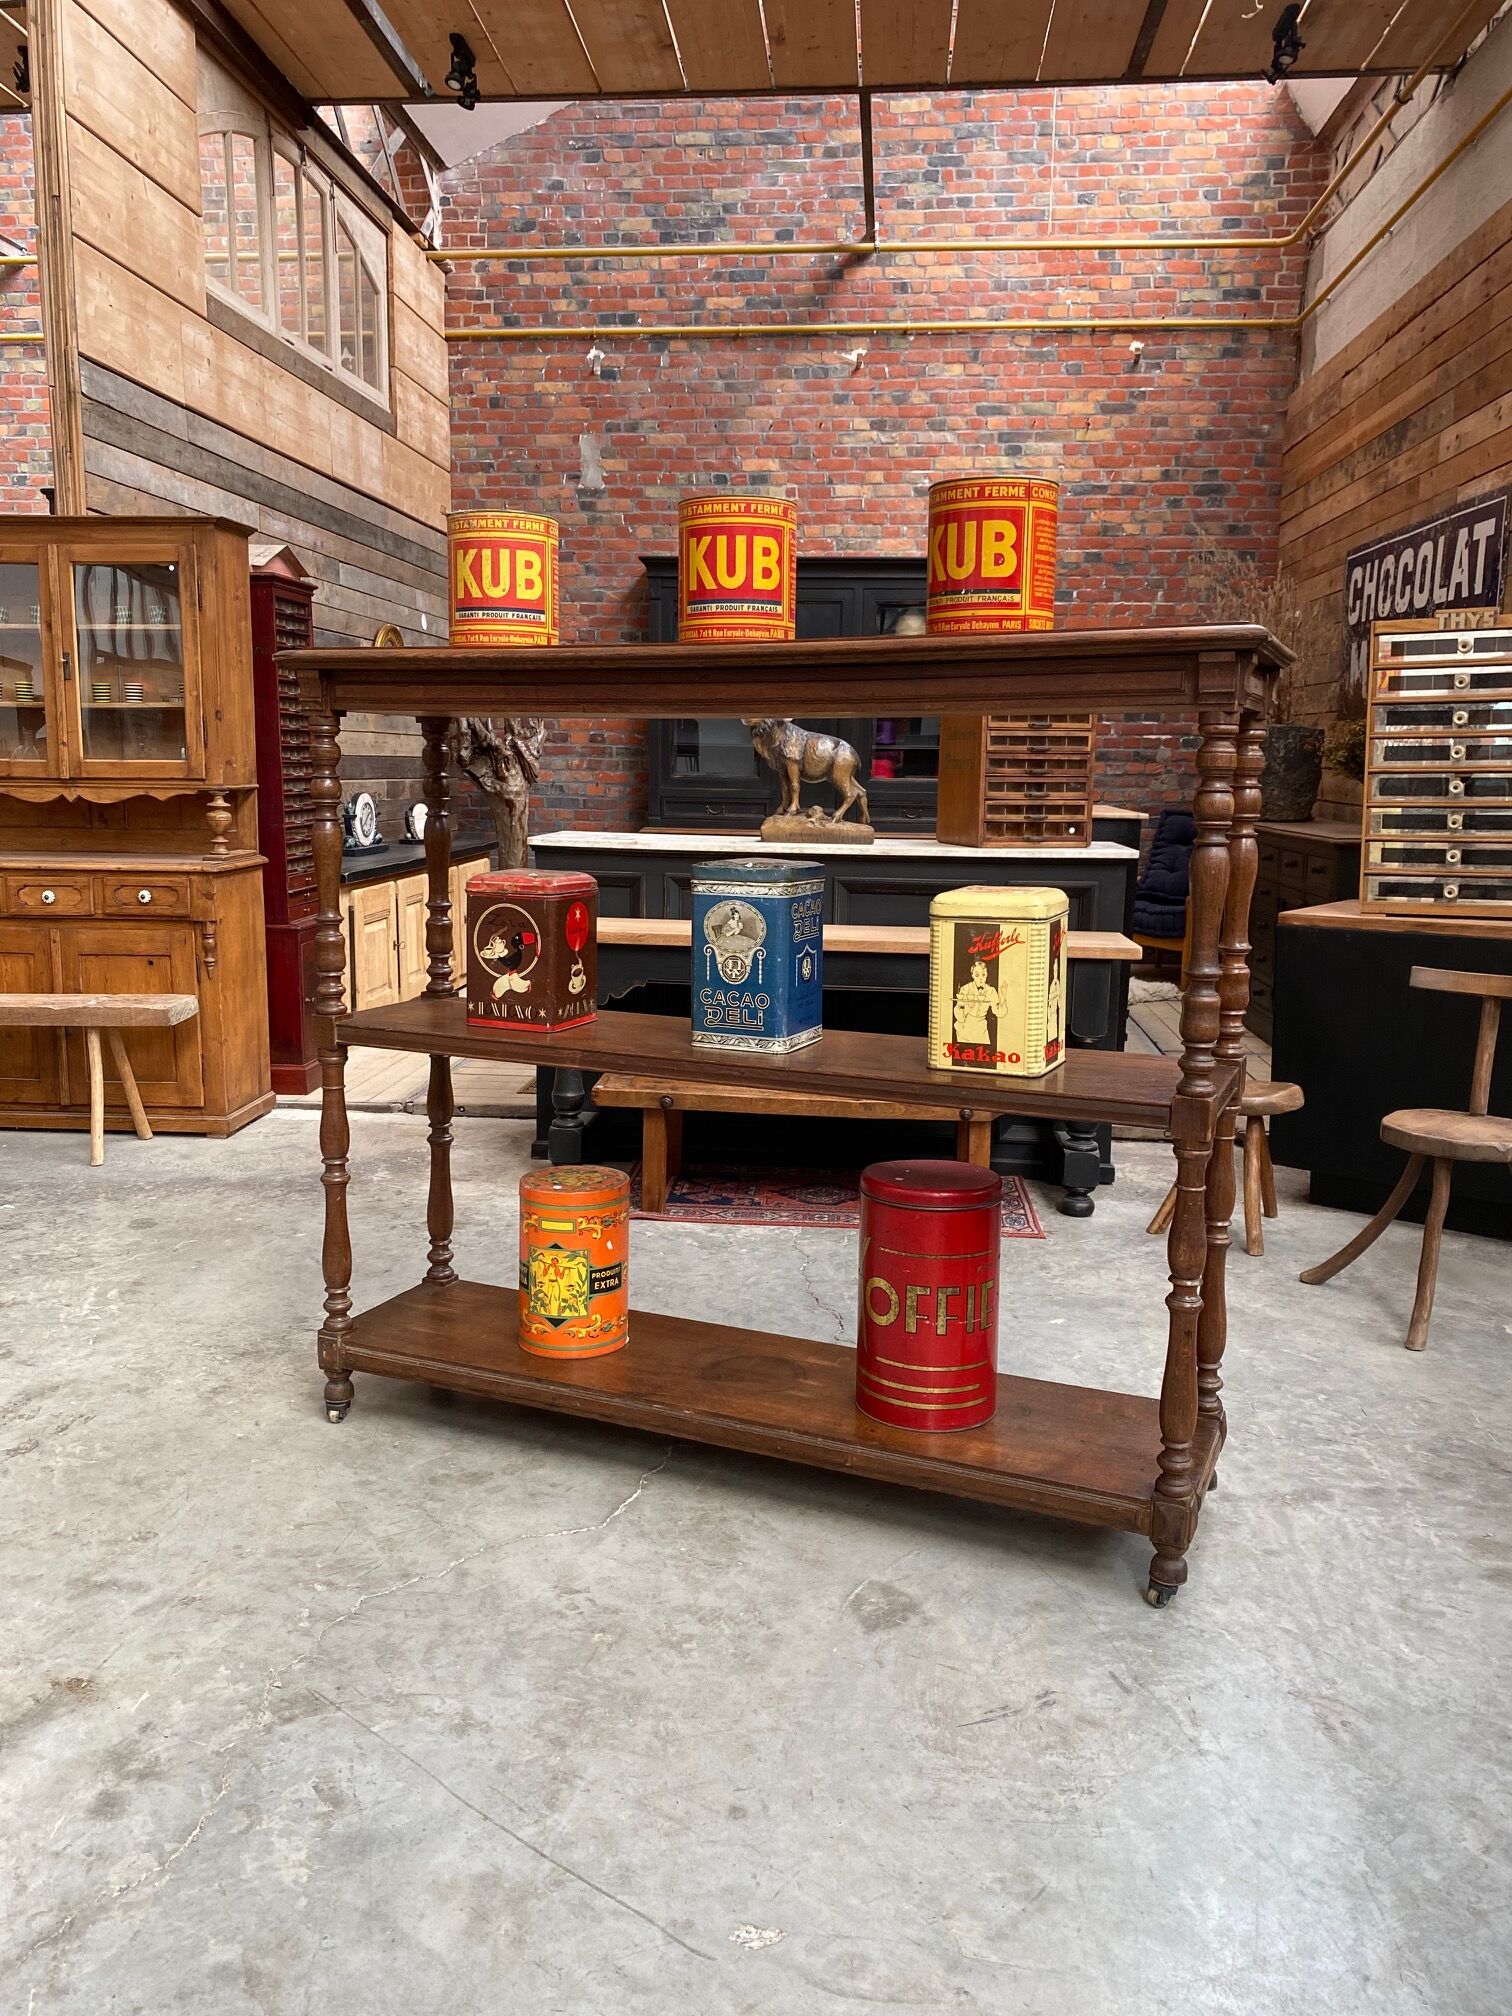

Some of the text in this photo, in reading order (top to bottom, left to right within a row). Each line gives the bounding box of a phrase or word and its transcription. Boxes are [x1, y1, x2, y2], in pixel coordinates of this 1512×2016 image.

[928, 519, 1018, 584] KUB
[689, 535, 780, 591] KUB
[1348, 518, 1497, 626] CHOCOLAT
[456, 548, 544, 601] KUB
[748, 605, 778, 613] FRANÇAIS
[946, 596, 974, 604] PRODUIT
[512, 613, 542, 621] FRANÇAIS
[1002, 620, 1022, 630] PARIS
[791, 898, 822, 920] CACAO
[700, 988, 770, 1010] CACAO
[942, 1042, 1021, 1065] Kakao
[594, 1277, 619, 1290] EXTRA
